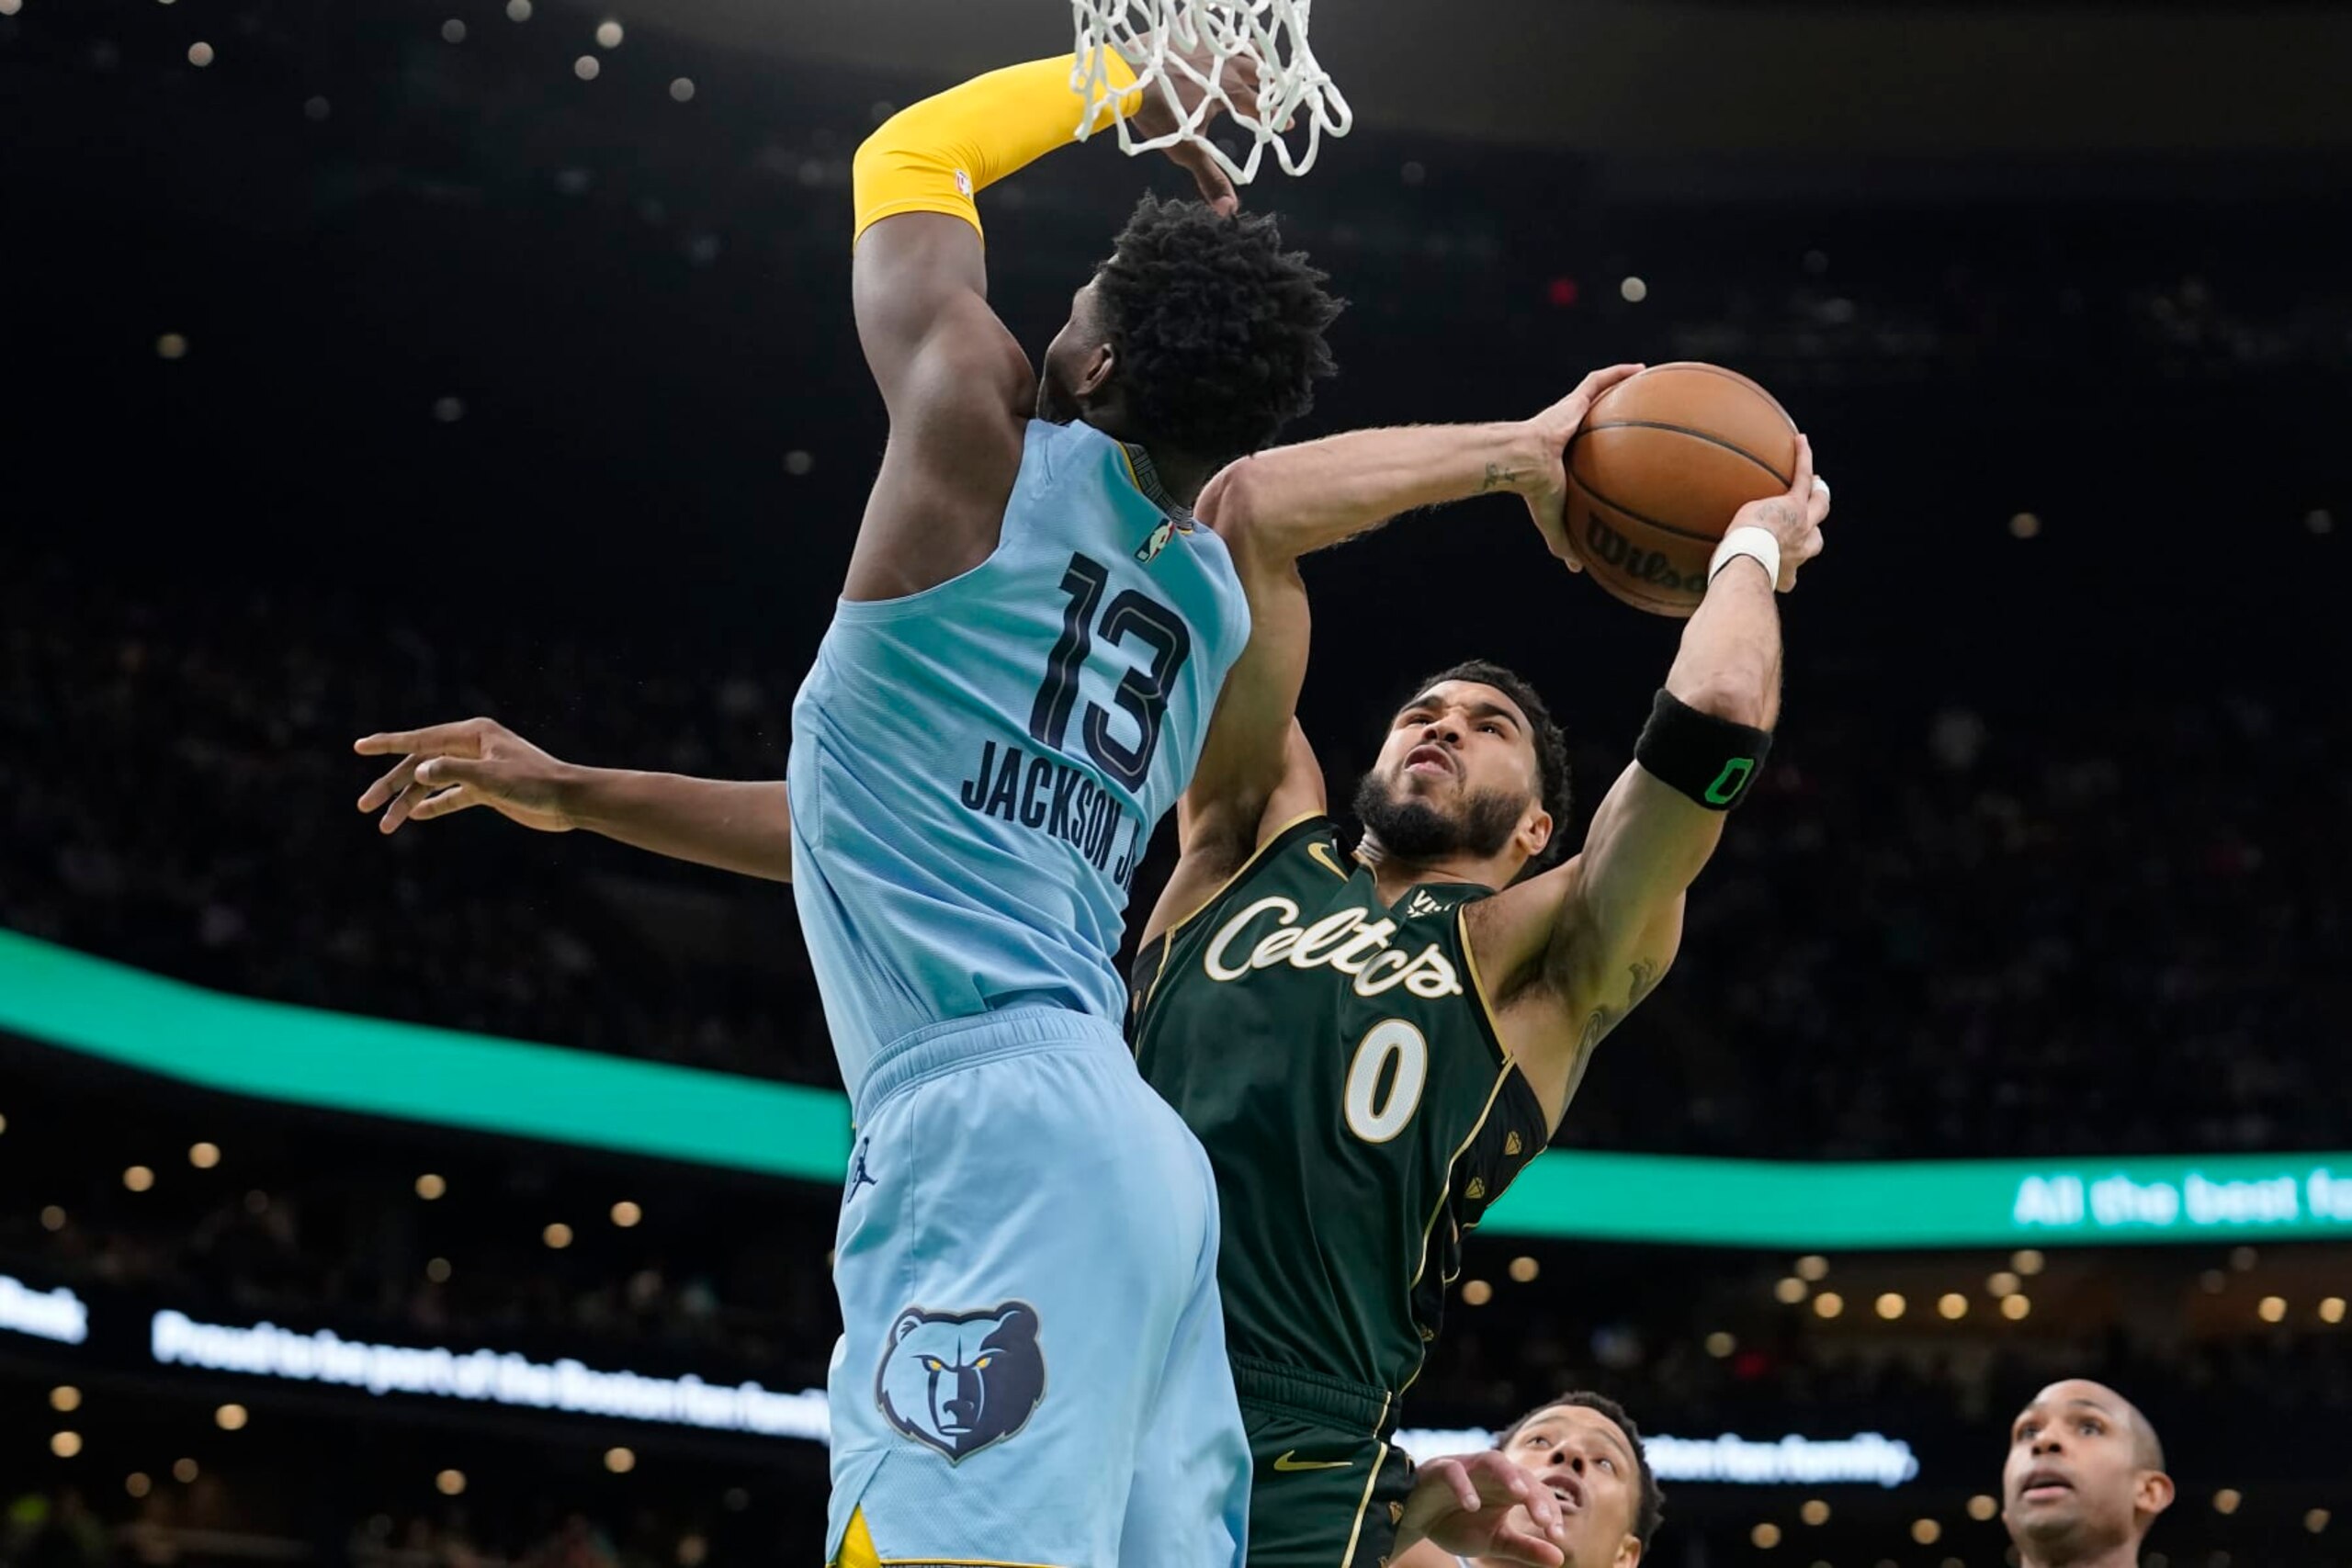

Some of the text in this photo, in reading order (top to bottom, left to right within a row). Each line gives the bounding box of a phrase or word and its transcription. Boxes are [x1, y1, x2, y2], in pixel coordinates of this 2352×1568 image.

[1587, 511, 1707, 593] Wilso
[1030, 551, 1192, 794] 13
[961, 740, 1123, 873] JACKSON
[1704, 757, 1755, 805] 0
[1204, 896, 1464, 999] Celtcs
[1343, 1018, 1429, 1145] 0
[2013, 1175, 2085, 1226] All
[2088, 1174, 2180, 1226] the
[2182, 1171, 2299, 1224] best
